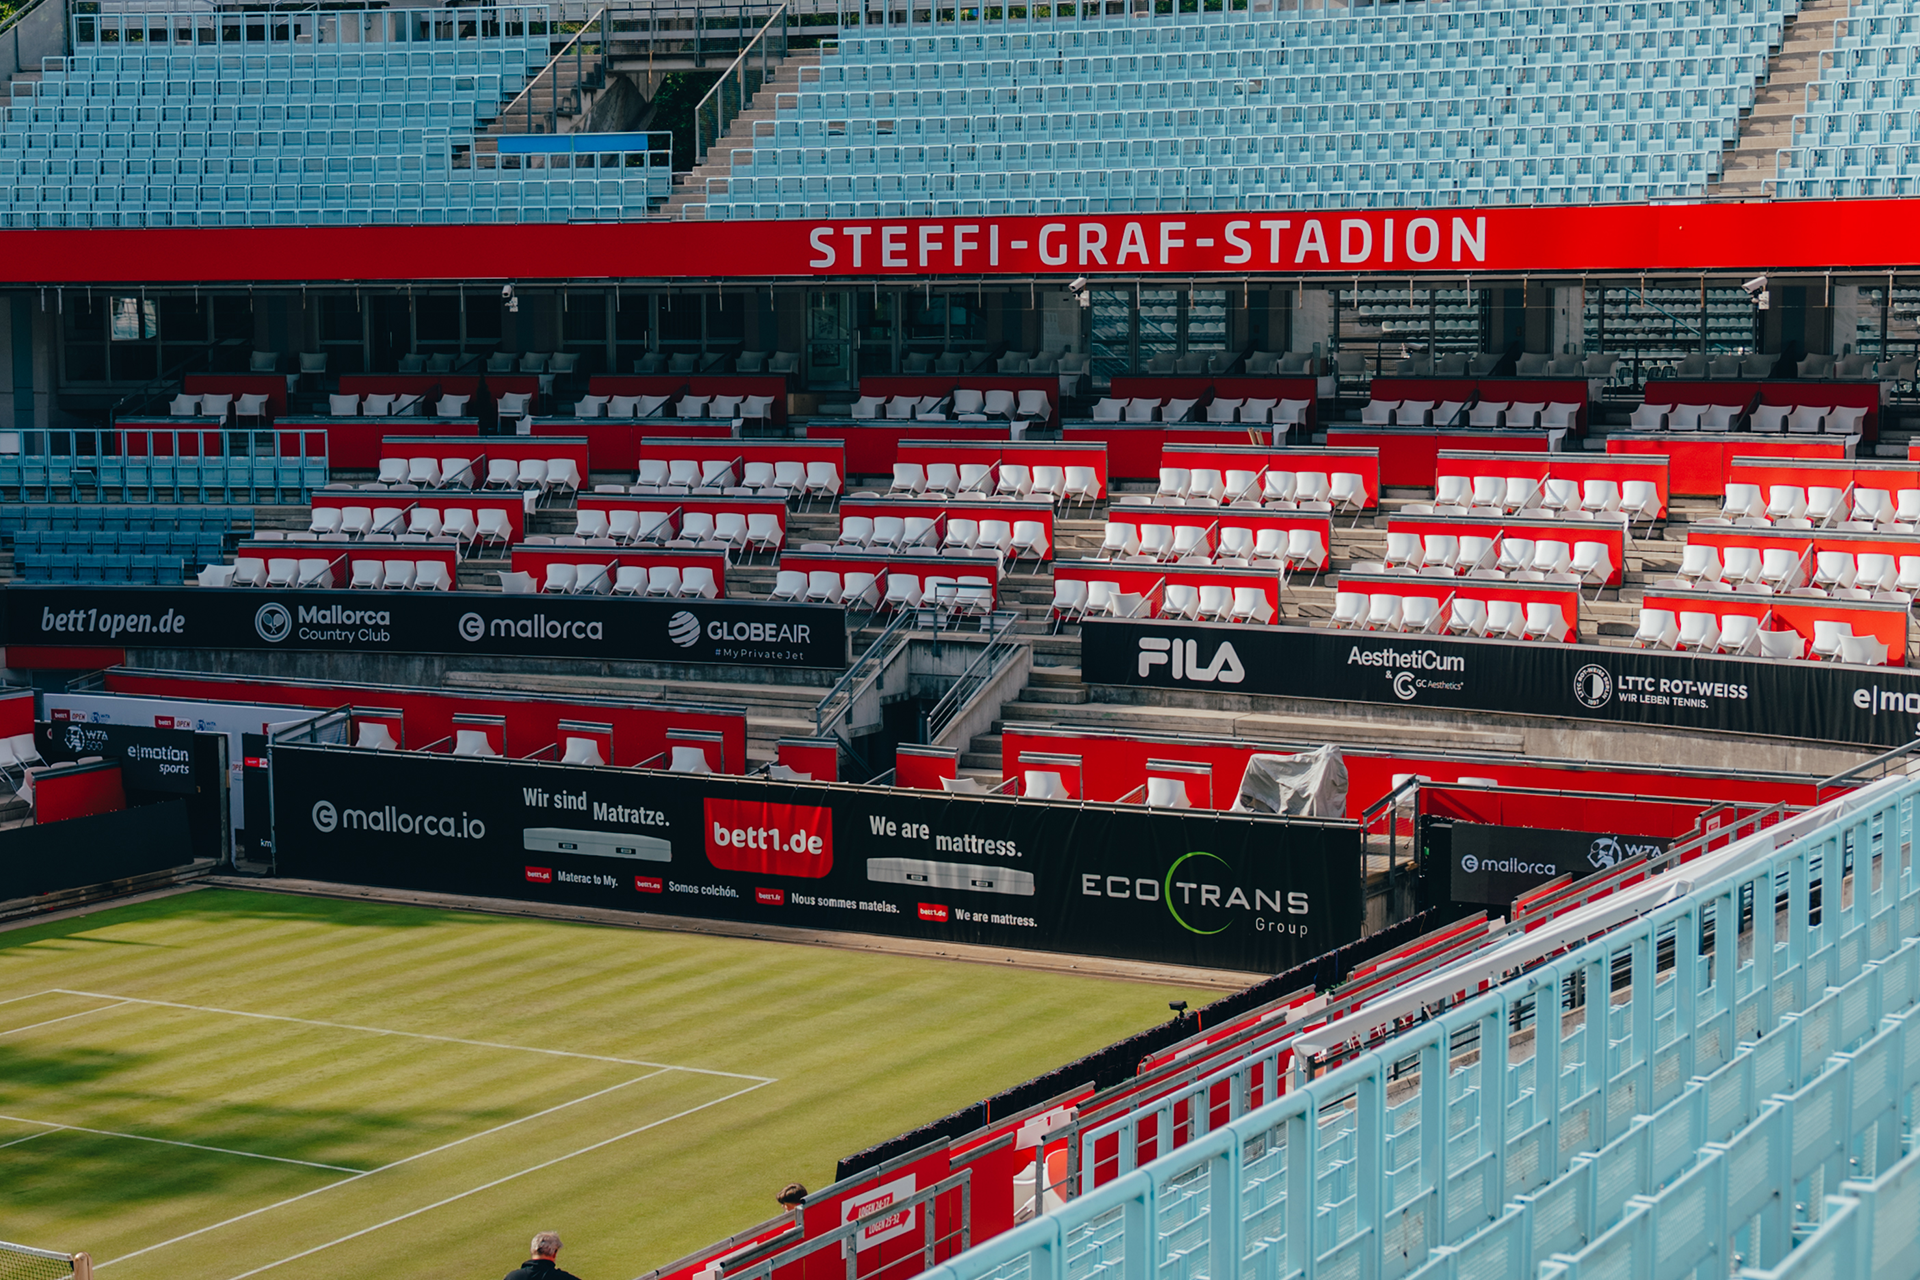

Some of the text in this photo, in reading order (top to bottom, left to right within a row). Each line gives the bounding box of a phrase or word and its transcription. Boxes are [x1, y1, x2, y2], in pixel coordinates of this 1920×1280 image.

[808, 216, 1487, 269] STEFFI-GRAF-STADION
[41, 606, 185, 639] bett1open.de
[299, 605, 390, 625] Mallorca
[299, 627, 390, 643] Country Club
[490, 614, 603, 640] mallorca
[707, 621, 811, 644] GLOBEAIR
[715, 648, 804, 661] #MyPrivateJet
[1138, 637, 1245, 683] FILA
[1347, 646, 1465, 672] AesthetiCum
[1385, 670, 1393, 679] &
[1415, 679, 1427, 688] GC
[1618, 675, 1748, 700] LTTC ROT-WEISS
[1618, 692, 1709, 709] WIR LEBEN TENNIS.
[85, 729, 109, 740] WTA
[86, 740, 103, 751] 500
[159, 762, 189, 775] sports
[523, 787, 670, 827] Wir sind Matratze.
[343, 805, 485, 839] mallorca.io
[713, 821, 823, 854] bett1.de
[869, 815, 1022, 857] We are mattress.
[1482, 858, 1556, 876] mallorca
[558, 870, 618, 888] Materac to My.
[669, 881, 739, 898] Somos colchón.
[791, 892, 900, 914] Nous sommes matelas.
[920, 907, 946, 917] bett1.de
[955, 908, 1038, 927] We are mattress.
[1255, 917, 1308, 938] Group
[868, 1221, 885, 1235] LOGEN
